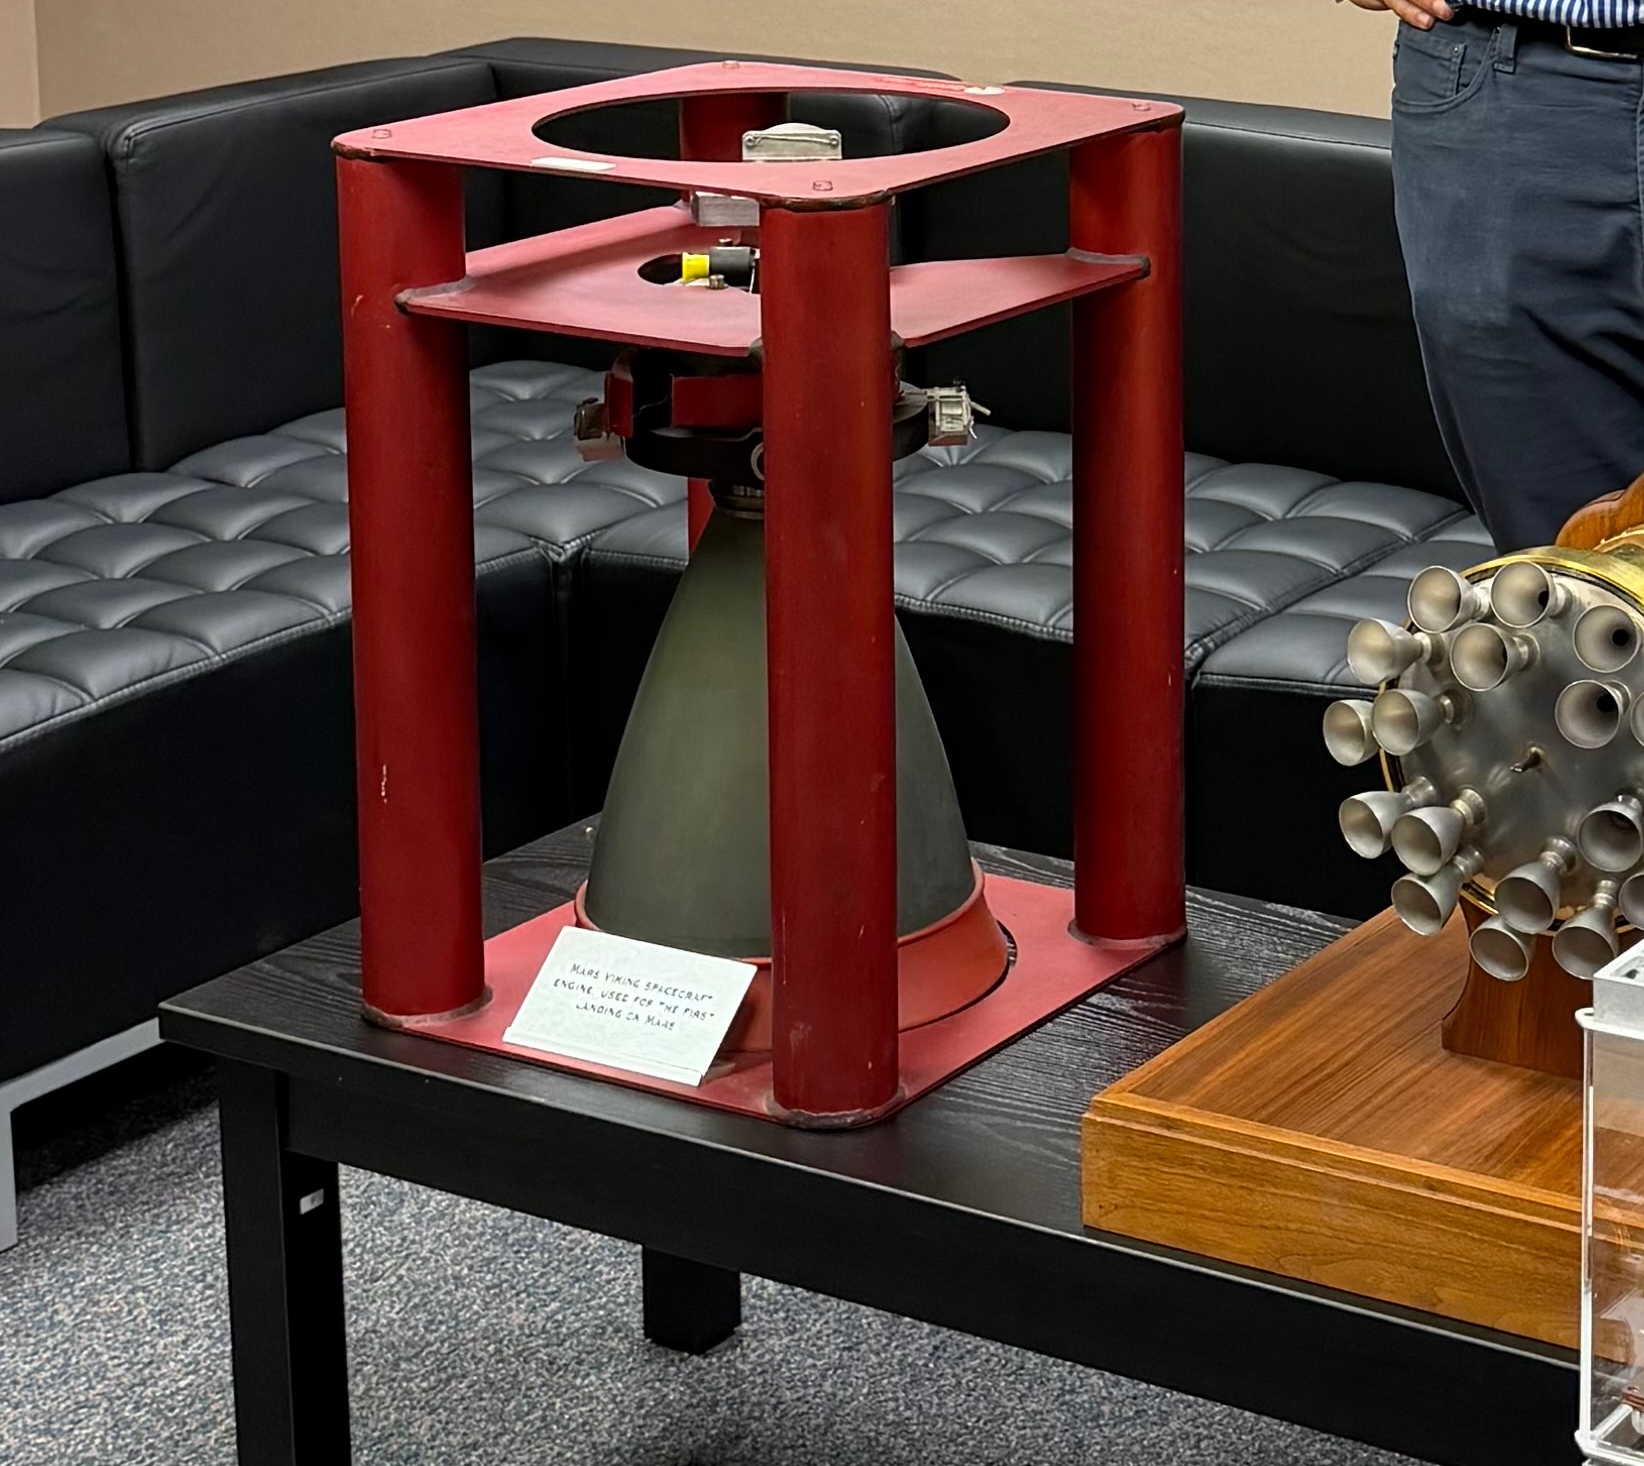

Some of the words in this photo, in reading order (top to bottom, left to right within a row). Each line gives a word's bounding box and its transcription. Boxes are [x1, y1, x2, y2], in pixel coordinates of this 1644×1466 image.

[569, 963, 600, 979] MARS
[605, 972, 641, 989] VIKING
[644, 981, 713, 1002] SPACECRAFT
[575, 1002, 622, 1019] LANDING
[644, 1014, 676, 1031] MARS
[600, 990, 629, 1003] USED
[633, 996, 653, 1008] FOR
[659, 1001, 679, 1014] THE
[682, 1007, 715, 1021] FIRST
